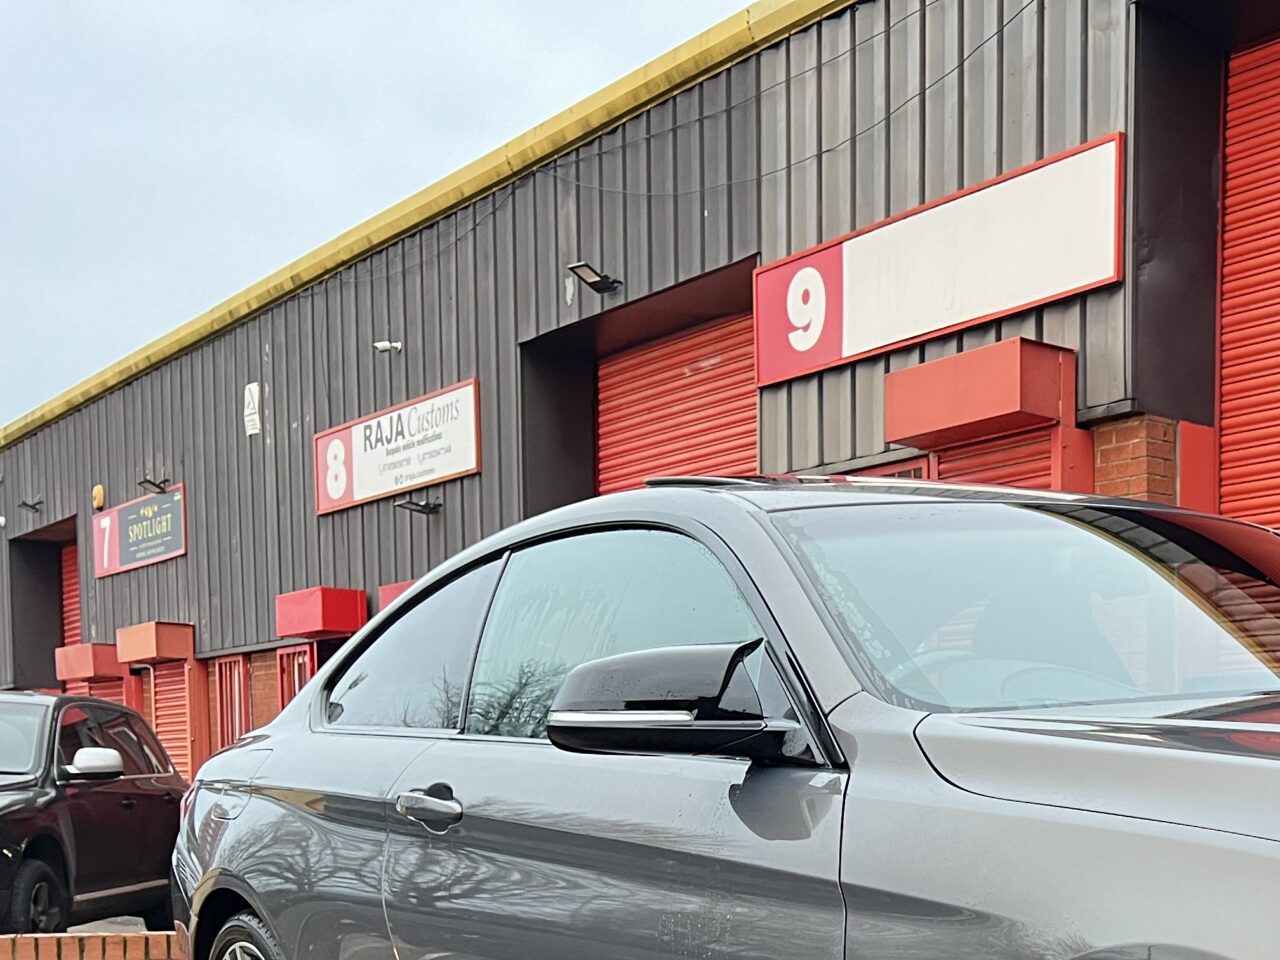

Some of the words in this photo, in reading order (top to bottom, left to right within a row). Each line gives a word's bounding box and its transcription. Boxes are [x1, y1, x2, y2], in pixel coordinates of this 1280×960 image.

[787, 267, 826, 352] 9
[363, 412, 406, 453] RAJA
[407, 399, 459, 437] Customs
[326, 438, 347, 500] 8
[100, 516, 111, 569] 7
[128, 513, 173, 544] SPOTLIGHT
